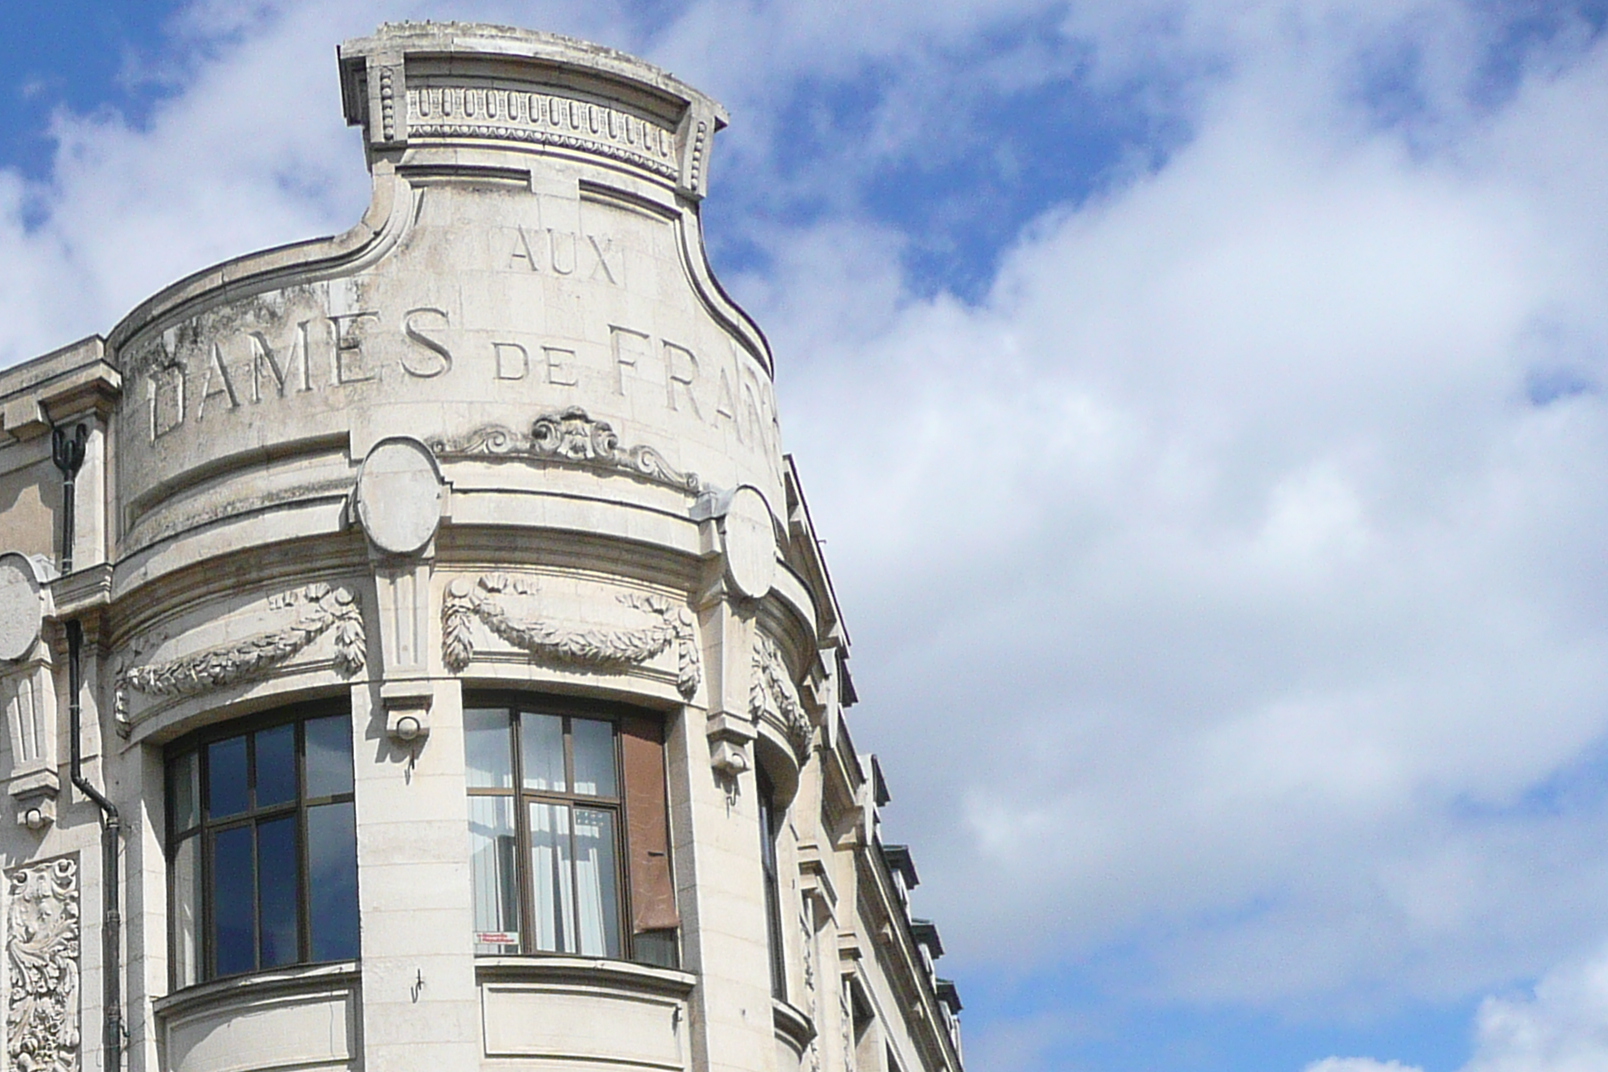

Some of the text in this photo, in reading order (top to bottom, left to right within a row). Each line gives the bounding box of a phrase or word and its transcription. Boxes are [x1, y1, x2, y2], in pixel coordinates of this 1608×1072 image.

[508, 224, 619, 286] AUX
[146, 306, 454, 448] DAMES
[491, 341, 580, 388] DE
